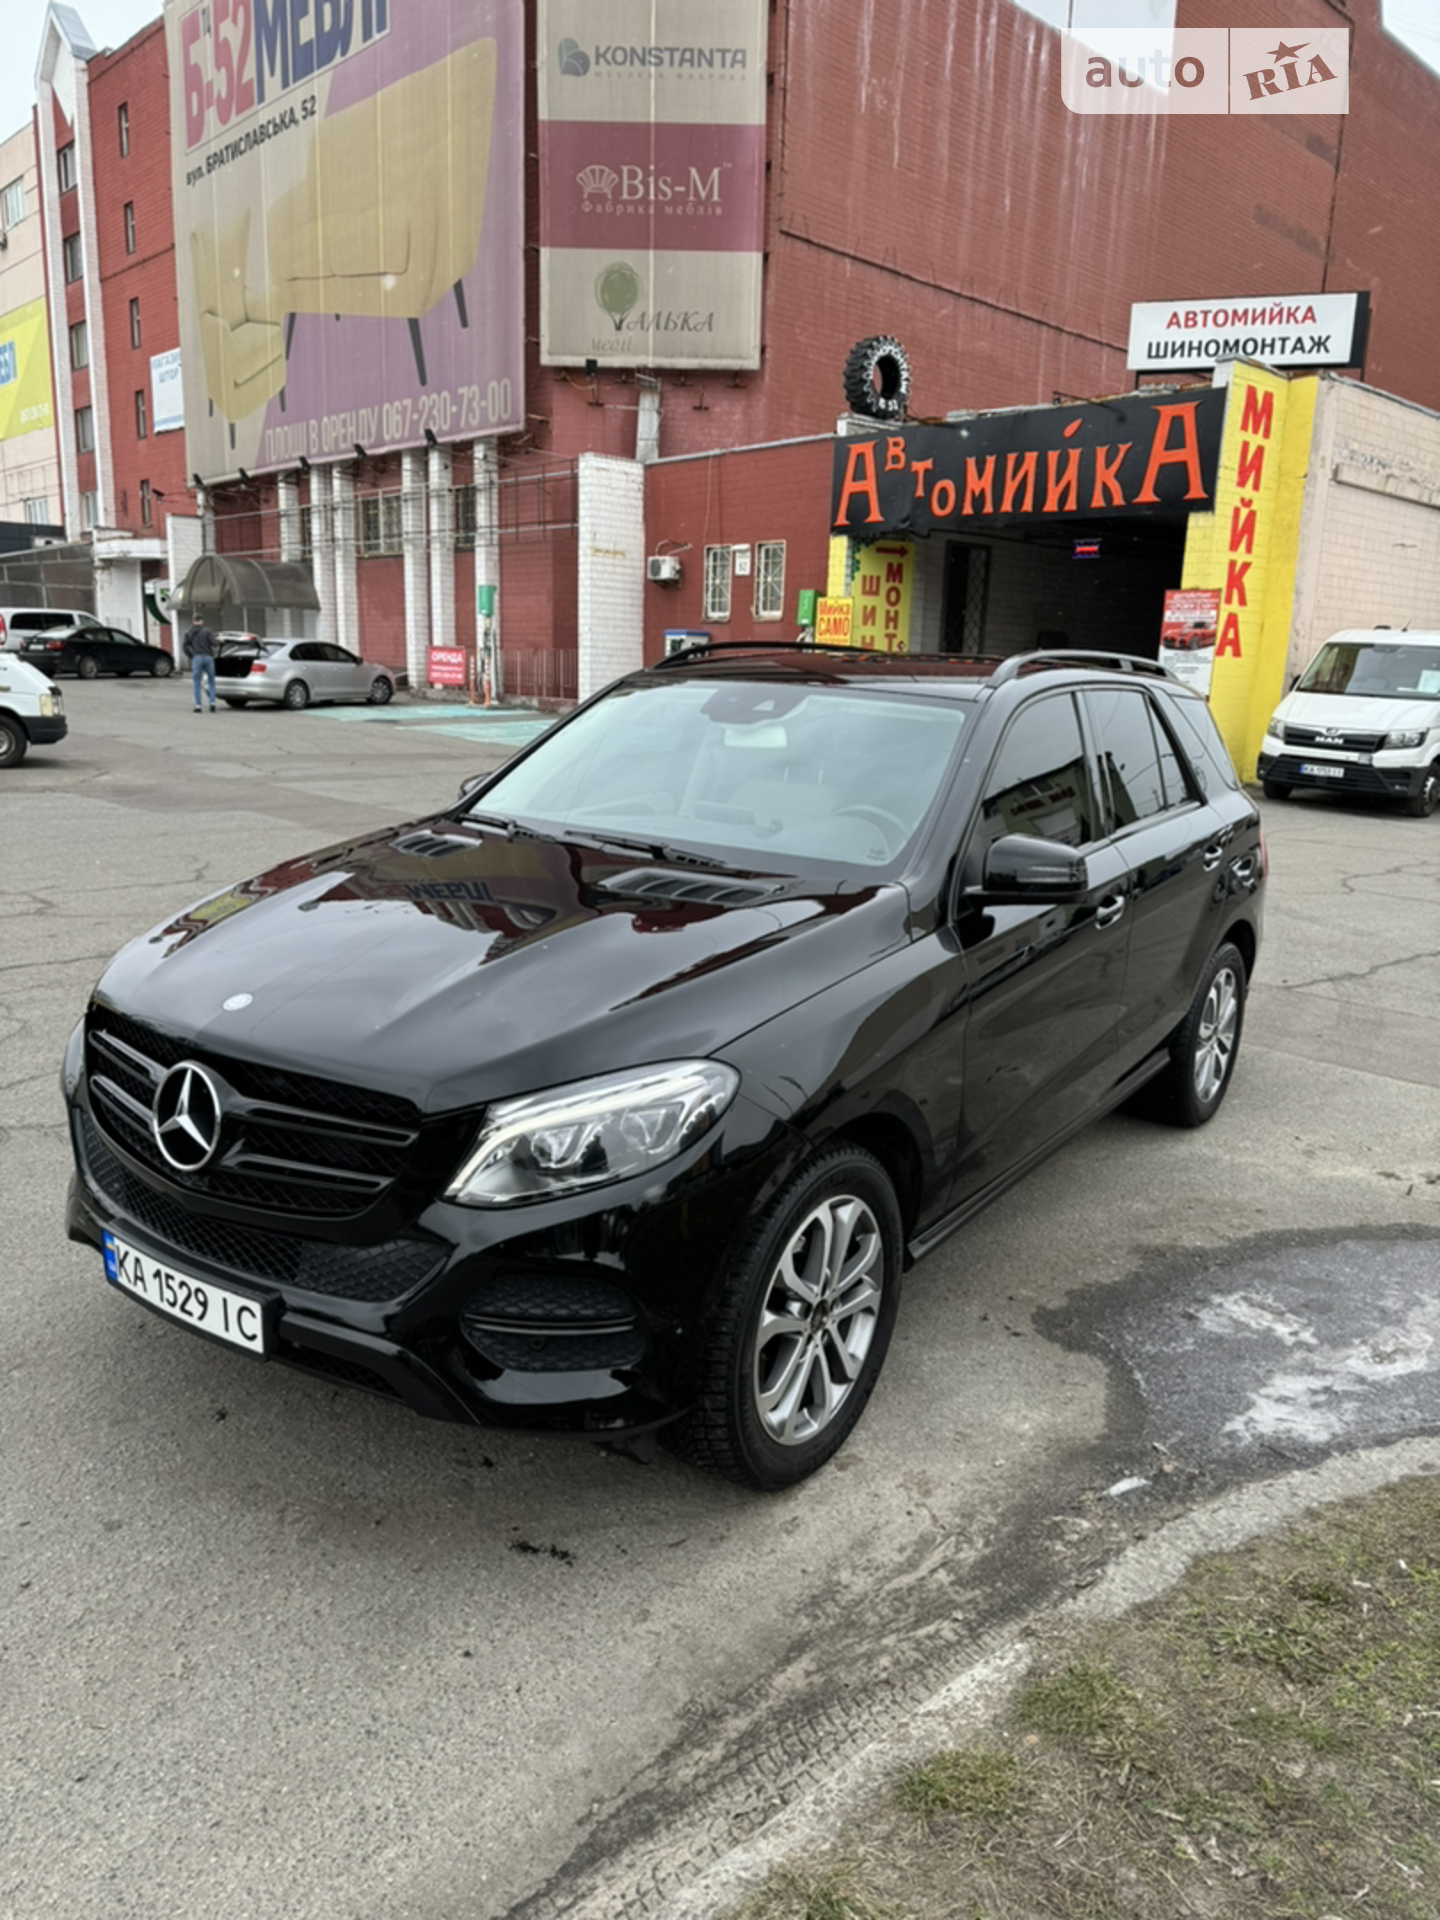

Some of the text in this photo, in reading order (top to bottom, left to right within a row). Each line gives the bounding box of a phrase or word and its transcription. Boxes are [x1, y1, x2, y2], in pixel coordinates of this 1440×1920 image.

[254, 0, 388, 107] МЕБ
[595, 46, 746, 69] KONSTANTA
[595, 71, 746, 81] МЕБЛЕВА ФАБРИКА
[301, 94, 317, 121] 52
[619, 165, 721, 201] Bis-M
[581, 201, 723, 216] Фабрика меблів
[1166, 303, 1317, 330] АВТОМИЙКА
[1146, 335, 1332, 360] ШИНОМОНТАЖ
[309, 418, 318, 454] В
[321, 406, 379, 453] ОРЕНДУ
[382, 377, 512, 441] 067-230-73-00
[1214, 384, 1274, 657] МИЙКА
[818, 616, 850, 637] САМО
[432, 651, 462, 664] ОРЕНДА
[1315, 735, 1344, 745] MAN
[116, 1245, 258, 1342] KA 1529 IC
